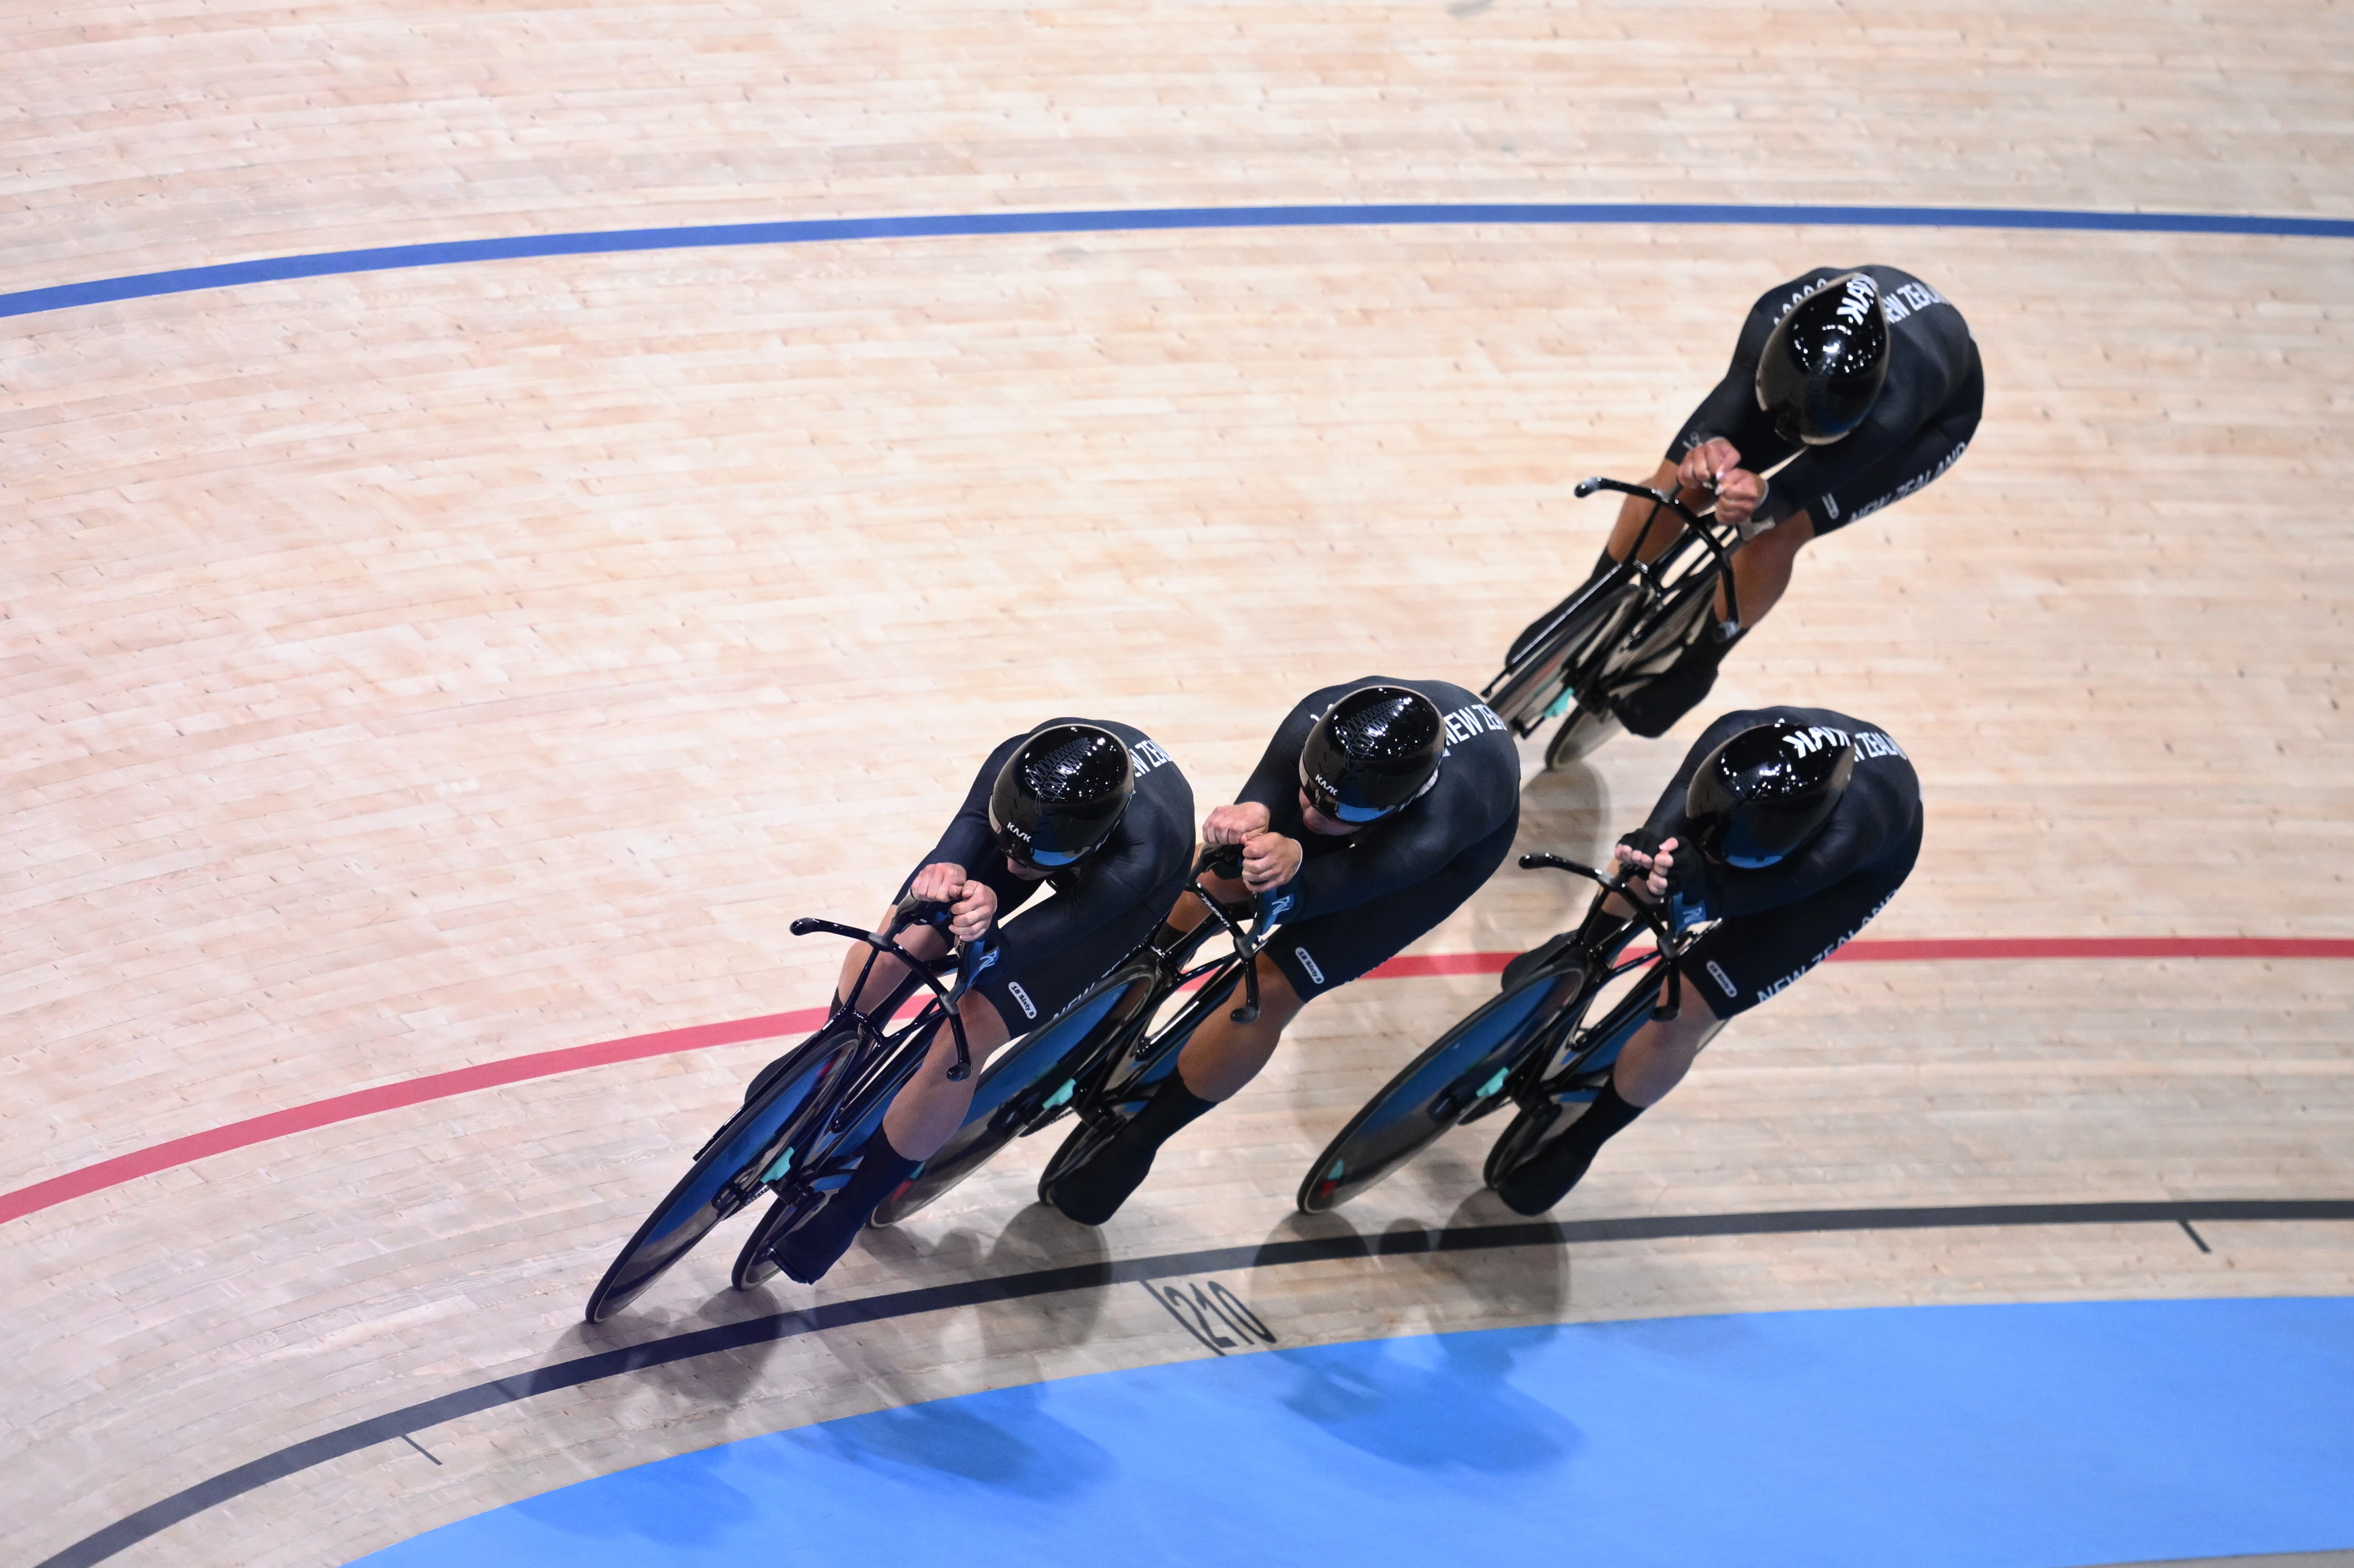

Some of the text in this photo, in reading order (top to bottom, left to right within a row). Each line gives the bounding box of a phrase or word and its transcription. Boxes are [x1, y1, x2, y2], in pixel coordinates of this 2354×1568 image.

[1896, 282, 1947, 311] ZEAL
[1315, 774, 1338, 796] KASK
[1007, 821, 1031, 843] KASK
[1011, 985, 1021, 994] 18
[1018, 994, 1031, 1011] Sixty
[1162, 1280, 1277, 1348] 210
